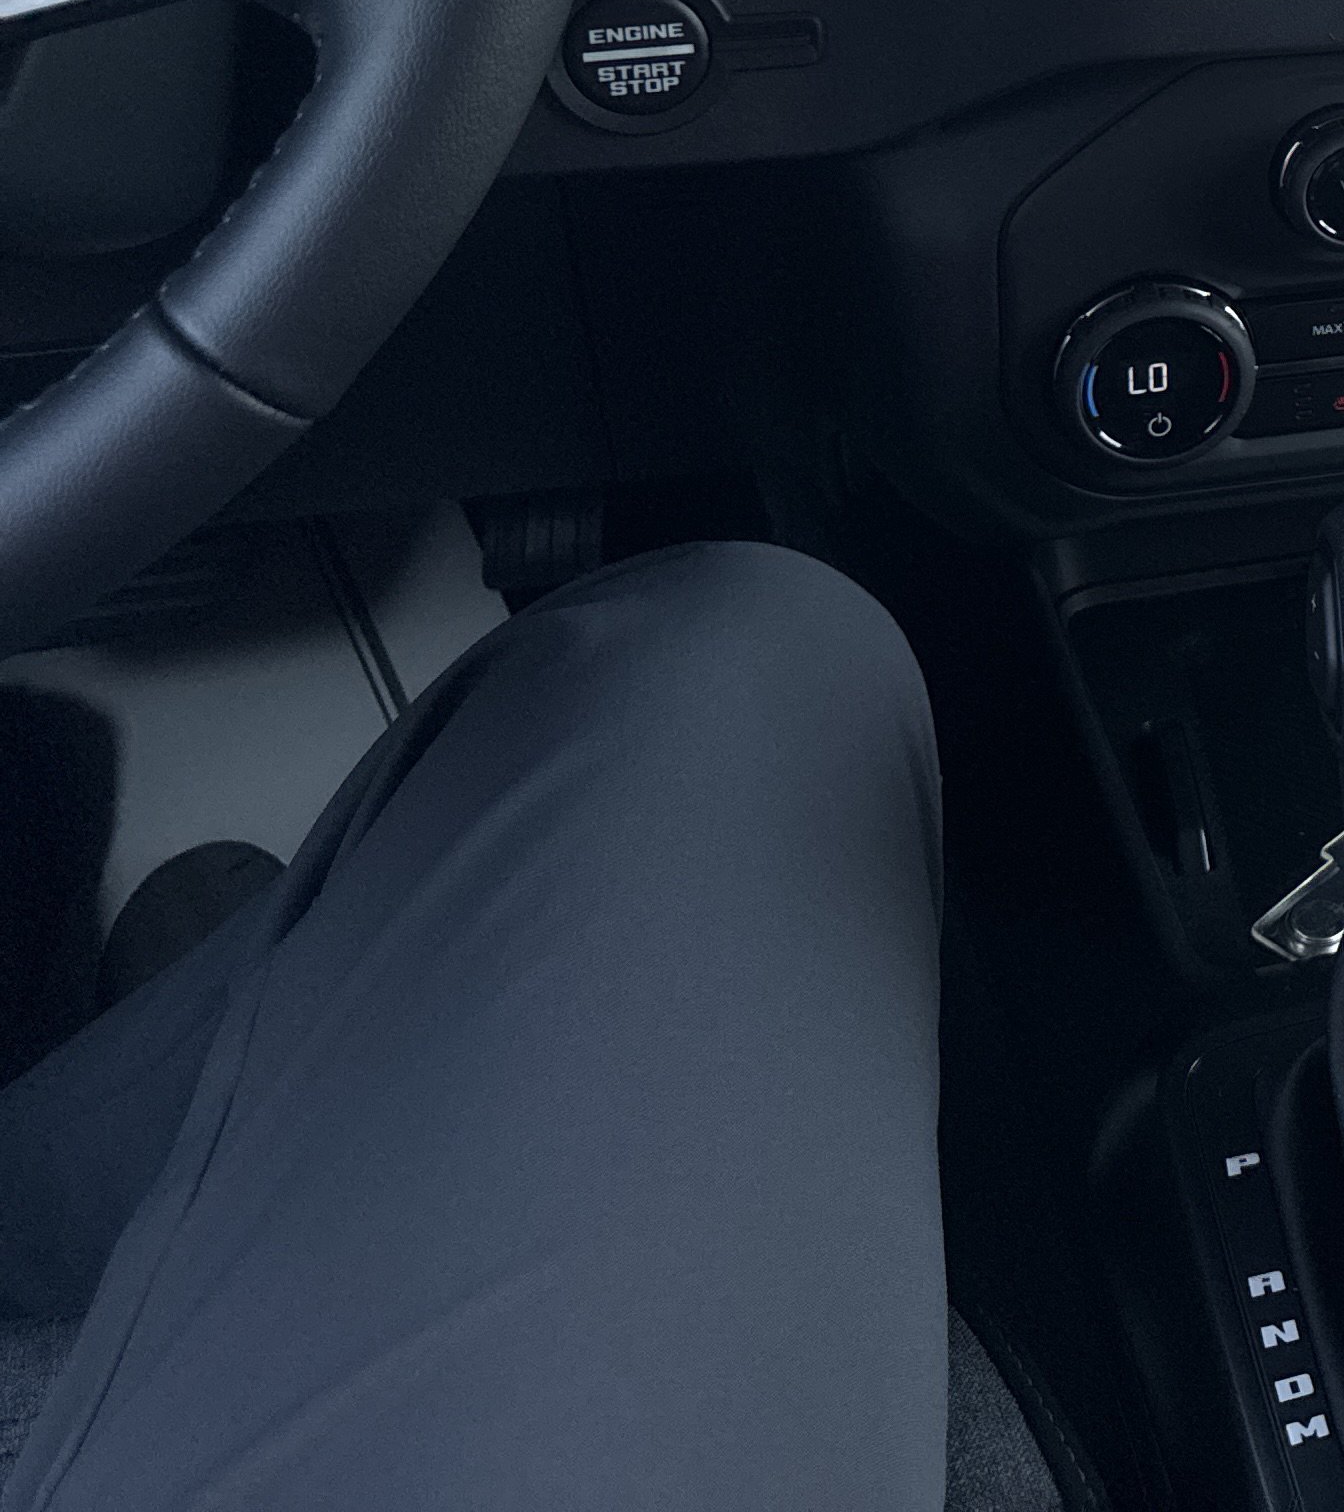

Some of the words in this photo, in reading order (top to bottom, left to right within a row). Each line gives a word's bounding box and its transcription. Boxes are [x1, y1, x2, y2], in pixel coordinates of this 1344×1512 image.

[588, 22, 685, 44] ENGINE
[597, 60, 686, 82] START
[610, 76, 680, 97] STOP
[1312, 323, 1343, 336] MAX
[1128, 362, 1168, 395] LO
[1226, 1152, 1260, 1177] P
[1261, 1319, 1299, 1348] N
[1274, 1373, 1314, 1402] D
[1286, 1414, 1330, 1446] M
